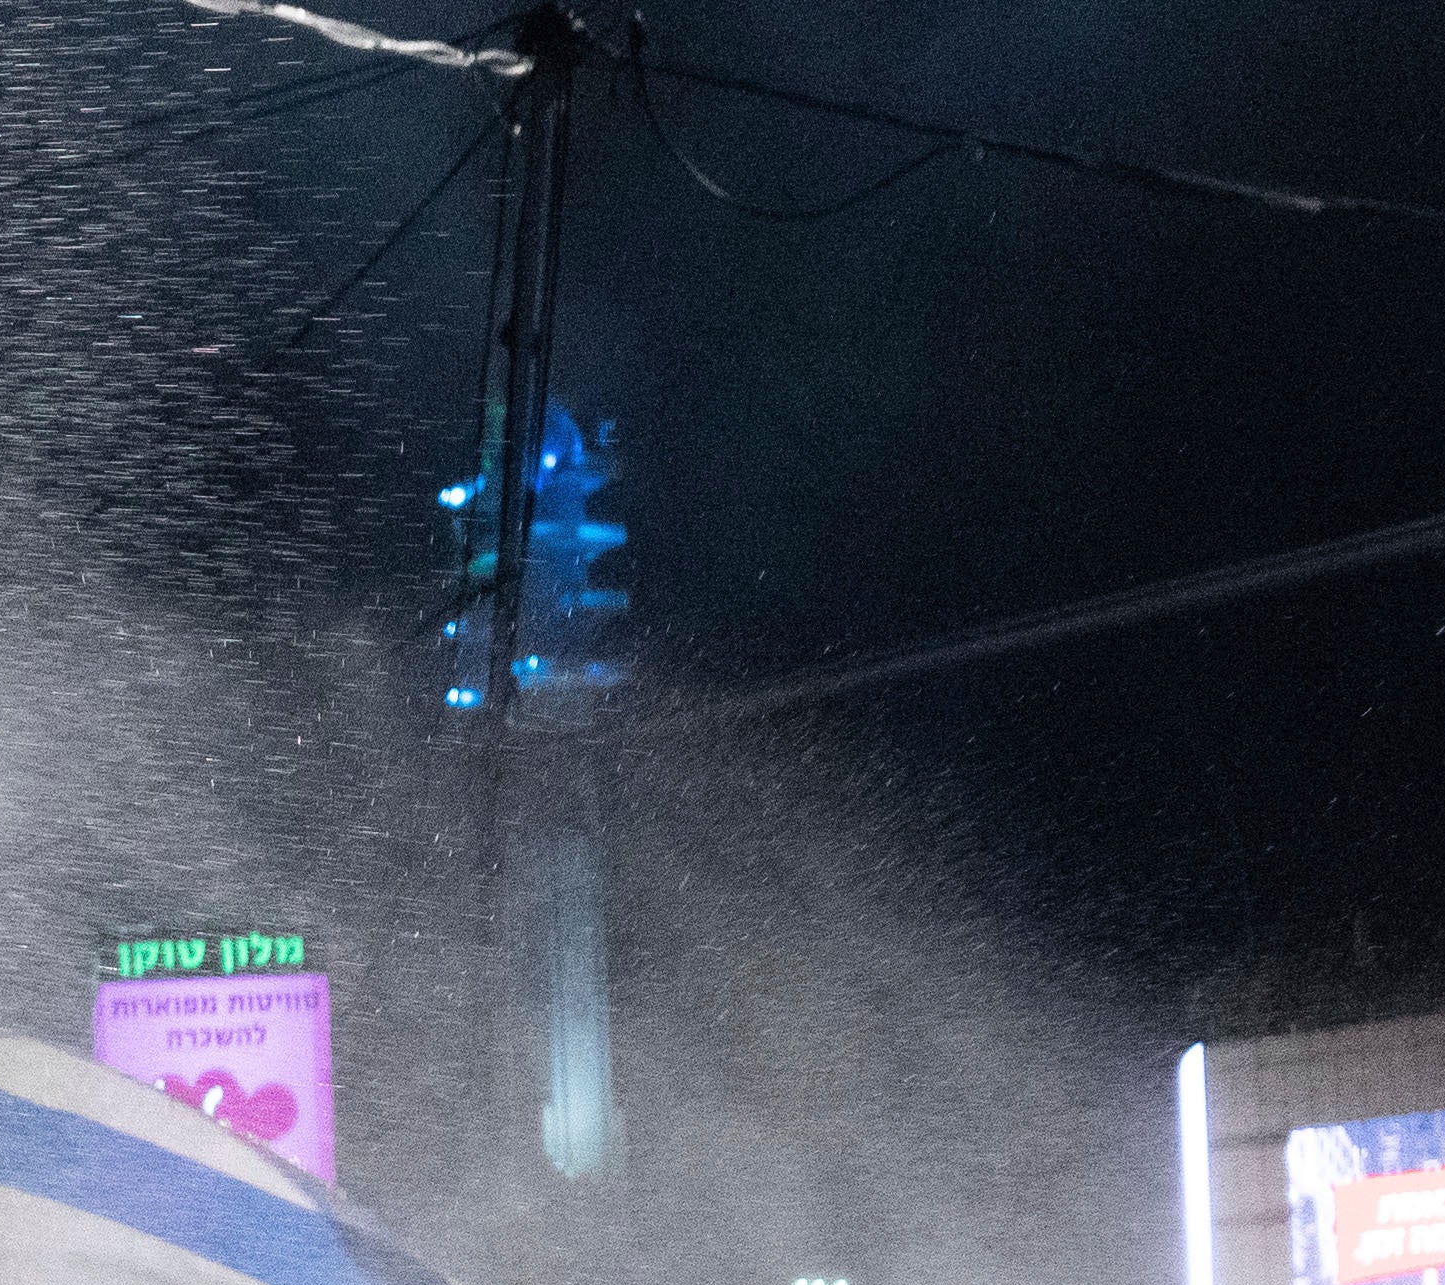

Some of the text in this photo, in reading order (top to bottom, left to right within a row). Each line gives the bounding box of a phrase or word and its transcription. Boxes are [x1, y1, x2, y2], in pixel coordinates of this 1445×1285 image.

[118, 931, 305, 977] מלון טוקן
[112, 994, 218, 1017] מפוארות
[167, 1021, 267, 1048] להשכרה
